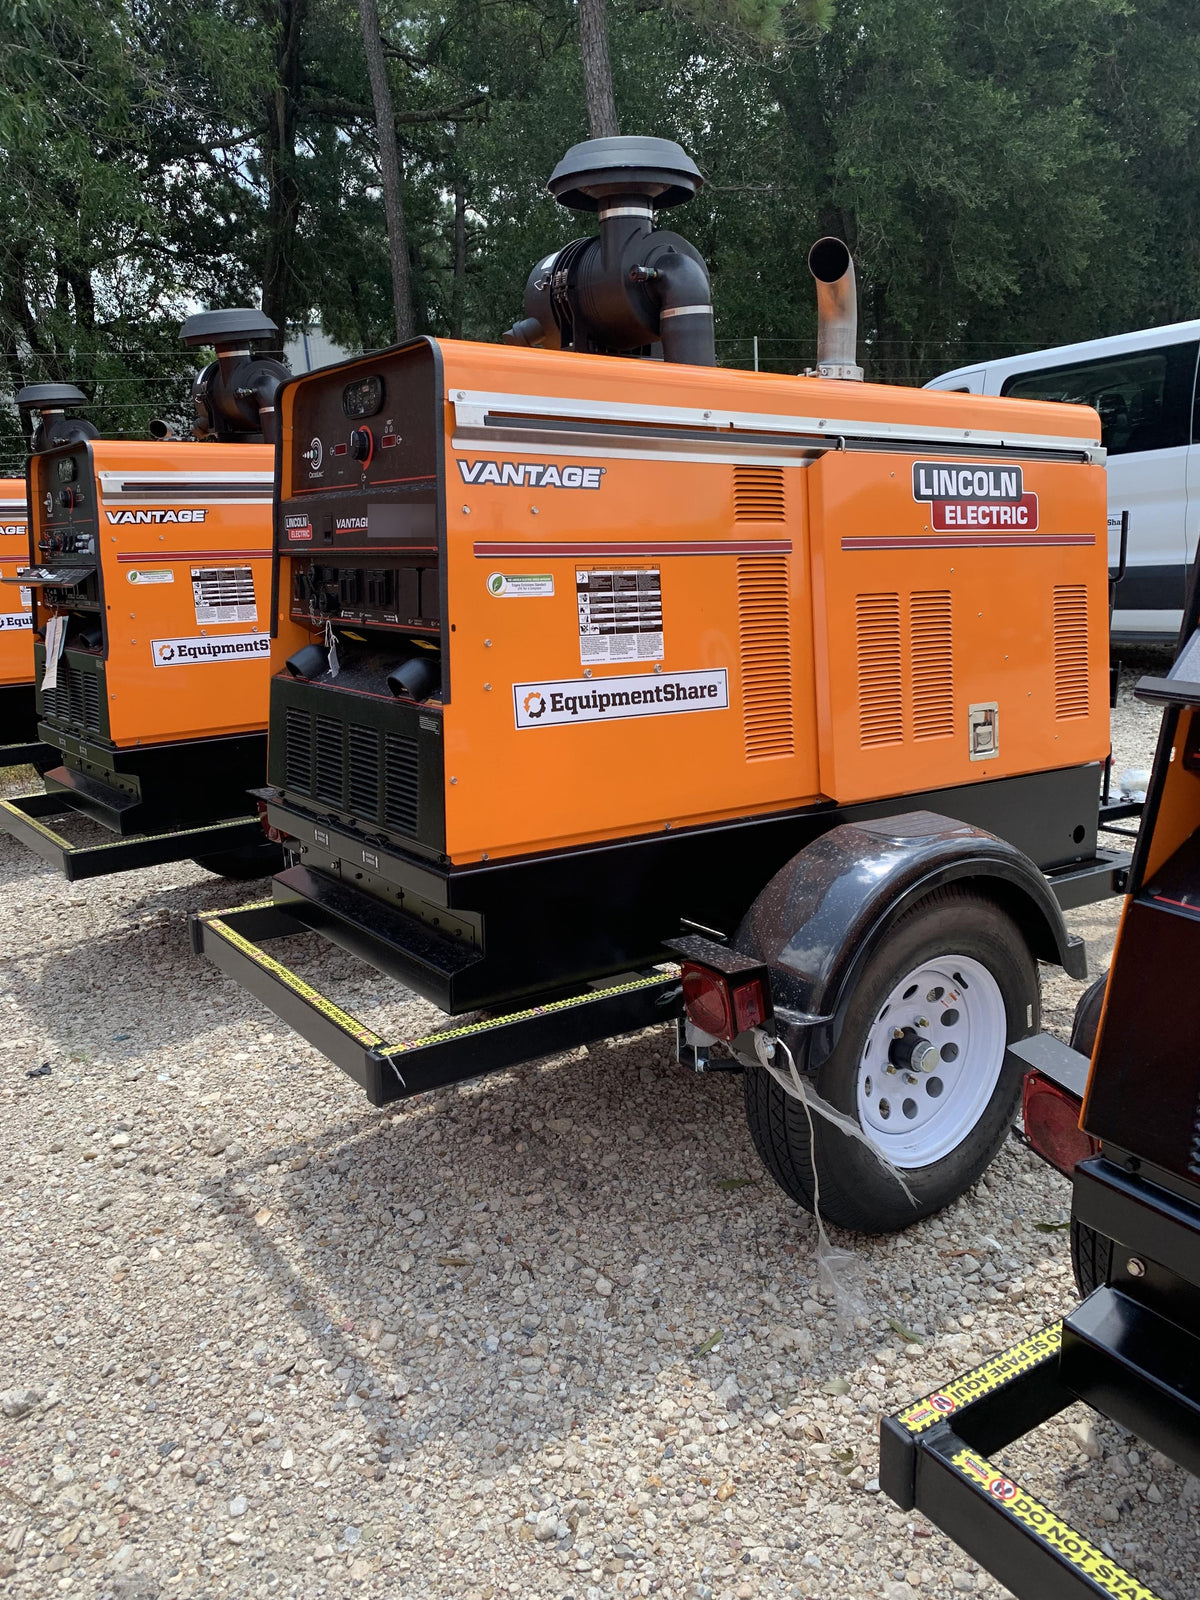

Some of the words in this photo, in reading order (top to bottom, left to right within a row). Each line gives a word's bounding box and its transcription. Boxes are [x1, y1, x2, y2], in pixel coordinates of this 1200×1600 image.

[457, 459, 601, 490] VANTAGE
[919, 468, 1017, 498] LINCOLN
[106, 510, 206, 525] VANTAGE
[945, 505, 1029, 525] ELECTRIC
[1107, 518, 1123, 526] Sha
[7, 614, 33, 629] Equi
[177, 639, 271, 659] EquipmentS
[550, 681, 718, 715] EquipmentShare
[1026, 1340, 1049, 1355] SE
[988, 1350, 1030, 1378] PARE
[1014, 1498, 1047, 1525] DO
[1048, 1526, 1097, 1562] NOT
